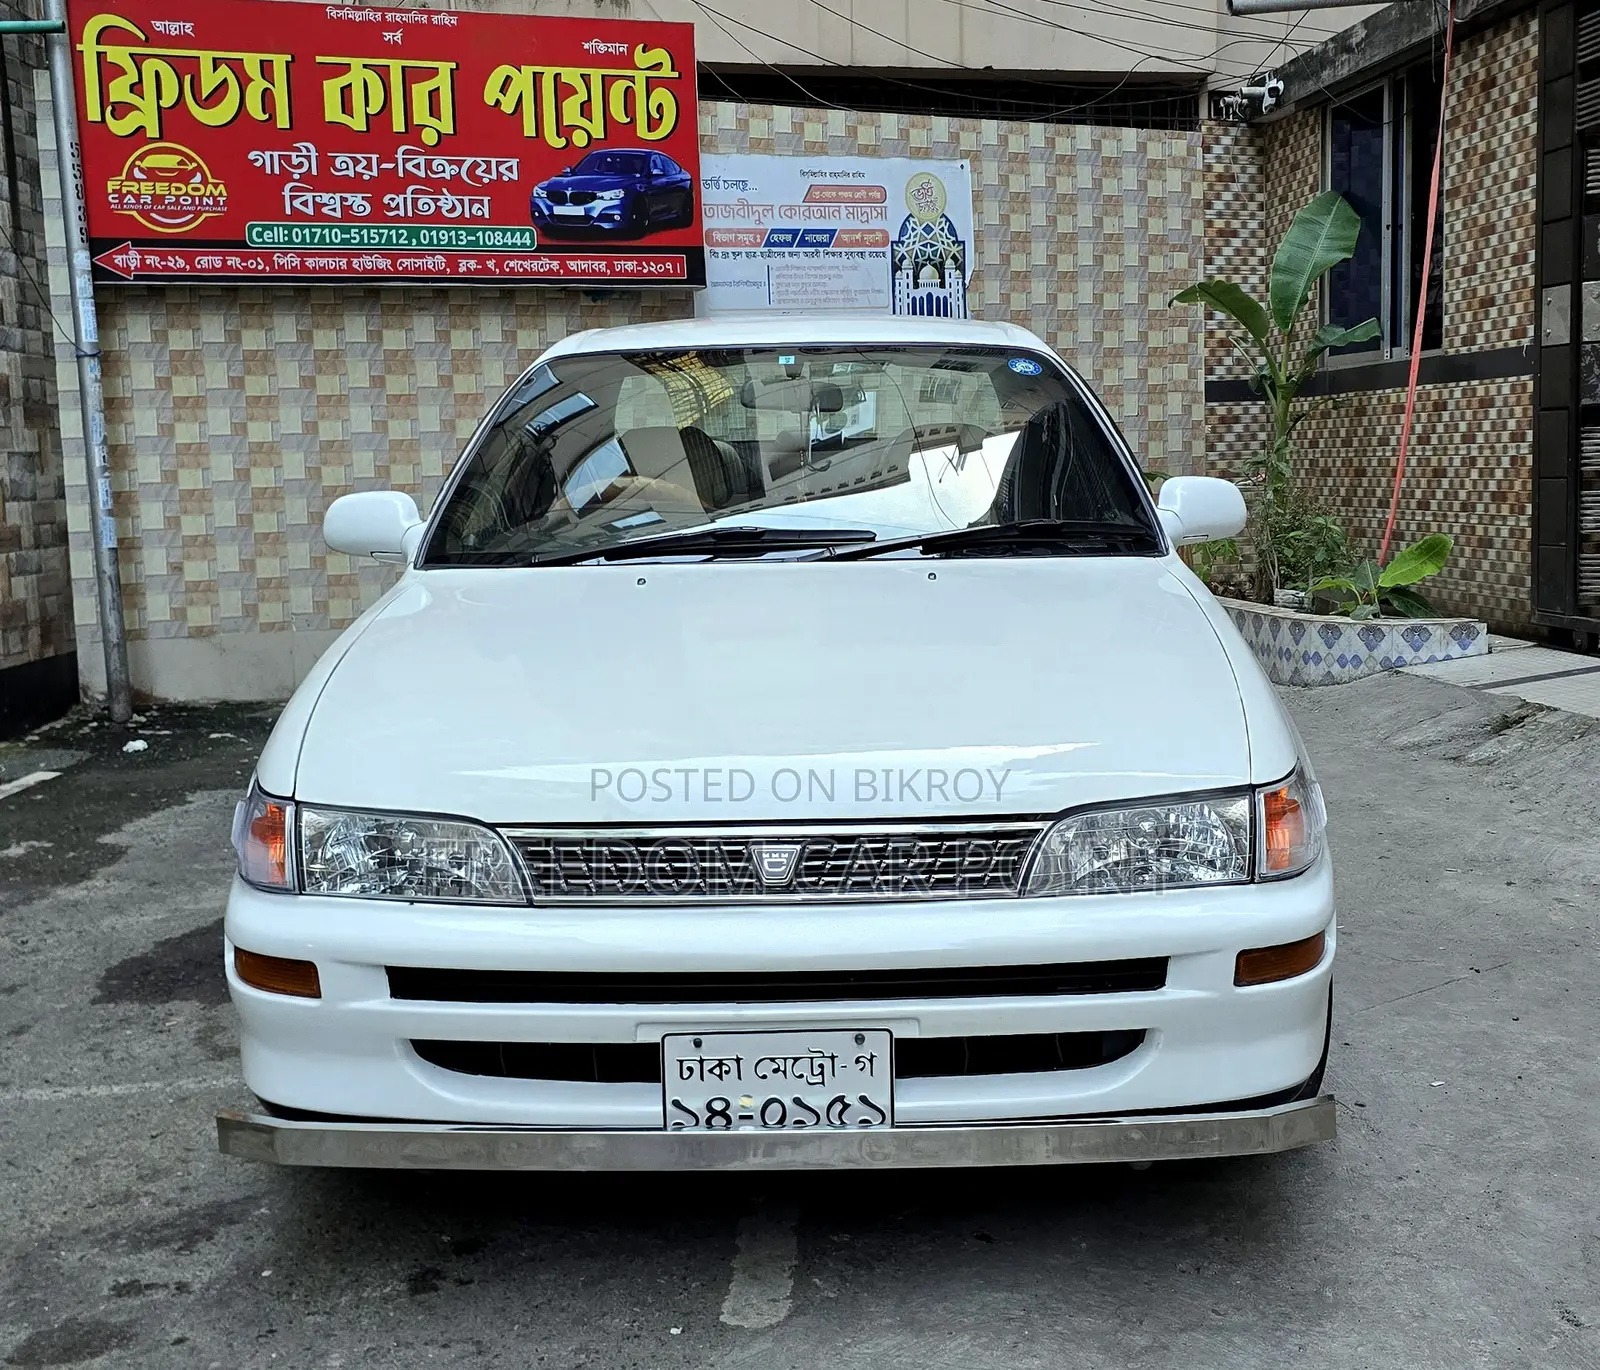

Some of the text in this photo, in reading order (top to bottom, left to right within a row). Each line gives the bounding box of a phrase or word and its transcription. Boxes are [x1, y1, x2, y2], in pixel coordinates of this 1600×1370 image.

[326, 6, 458, 27] বিসমিল্লাহির রাহমানির রাহিম
[151, 20, 629, 56] আল্লাহ সর্ব শক্তিমান
[76, 13, 680, 148] ফ্রিডম কার পয়েন্ট
[248, 143, 319, 180] গাড়ী
[107, 181, 227, 196] FREEDOM
[702, 176, 721, 191] ভর্তি
[108, 194, 227, 206] CAR POINT
[282, 182, 491, 219] বিশ্বস্ত প্রতিষ্ঠান
[703, 198, 888, 225] তাজবীদুল কোরআন মাদ্রাসা
[251, 227, 289, 243] Cell:
[420, 230, 531, 246] 01913-108444
[712, 231, 736, 243] বিভাগ
[770, 233, 793, 243] হেফজ
[804, 233, 830, 243] নাজেরা
[840, 231, 862, 243] আদর্শ
[113, 250, 142, 270] বাড়ী
[145, 255, 190, 271] নং-২৯,
[194, 255, 223, 269] রোড
[226, 255, 270, 272] নং-০১,
[273, 253, 301, 270] পিসি
[305, 256, 348, 271] কালচার
[351, 254, 394, 271] হাউজিং
[397, 254, 450, 274] সোসাইটি,
[503, 257, 564, 275] শেখেরটেক,
[566, 260, 610, 275] আদাবর,
[676, 1046, 877, 1087] ঢাকা মেট্রো- গ
